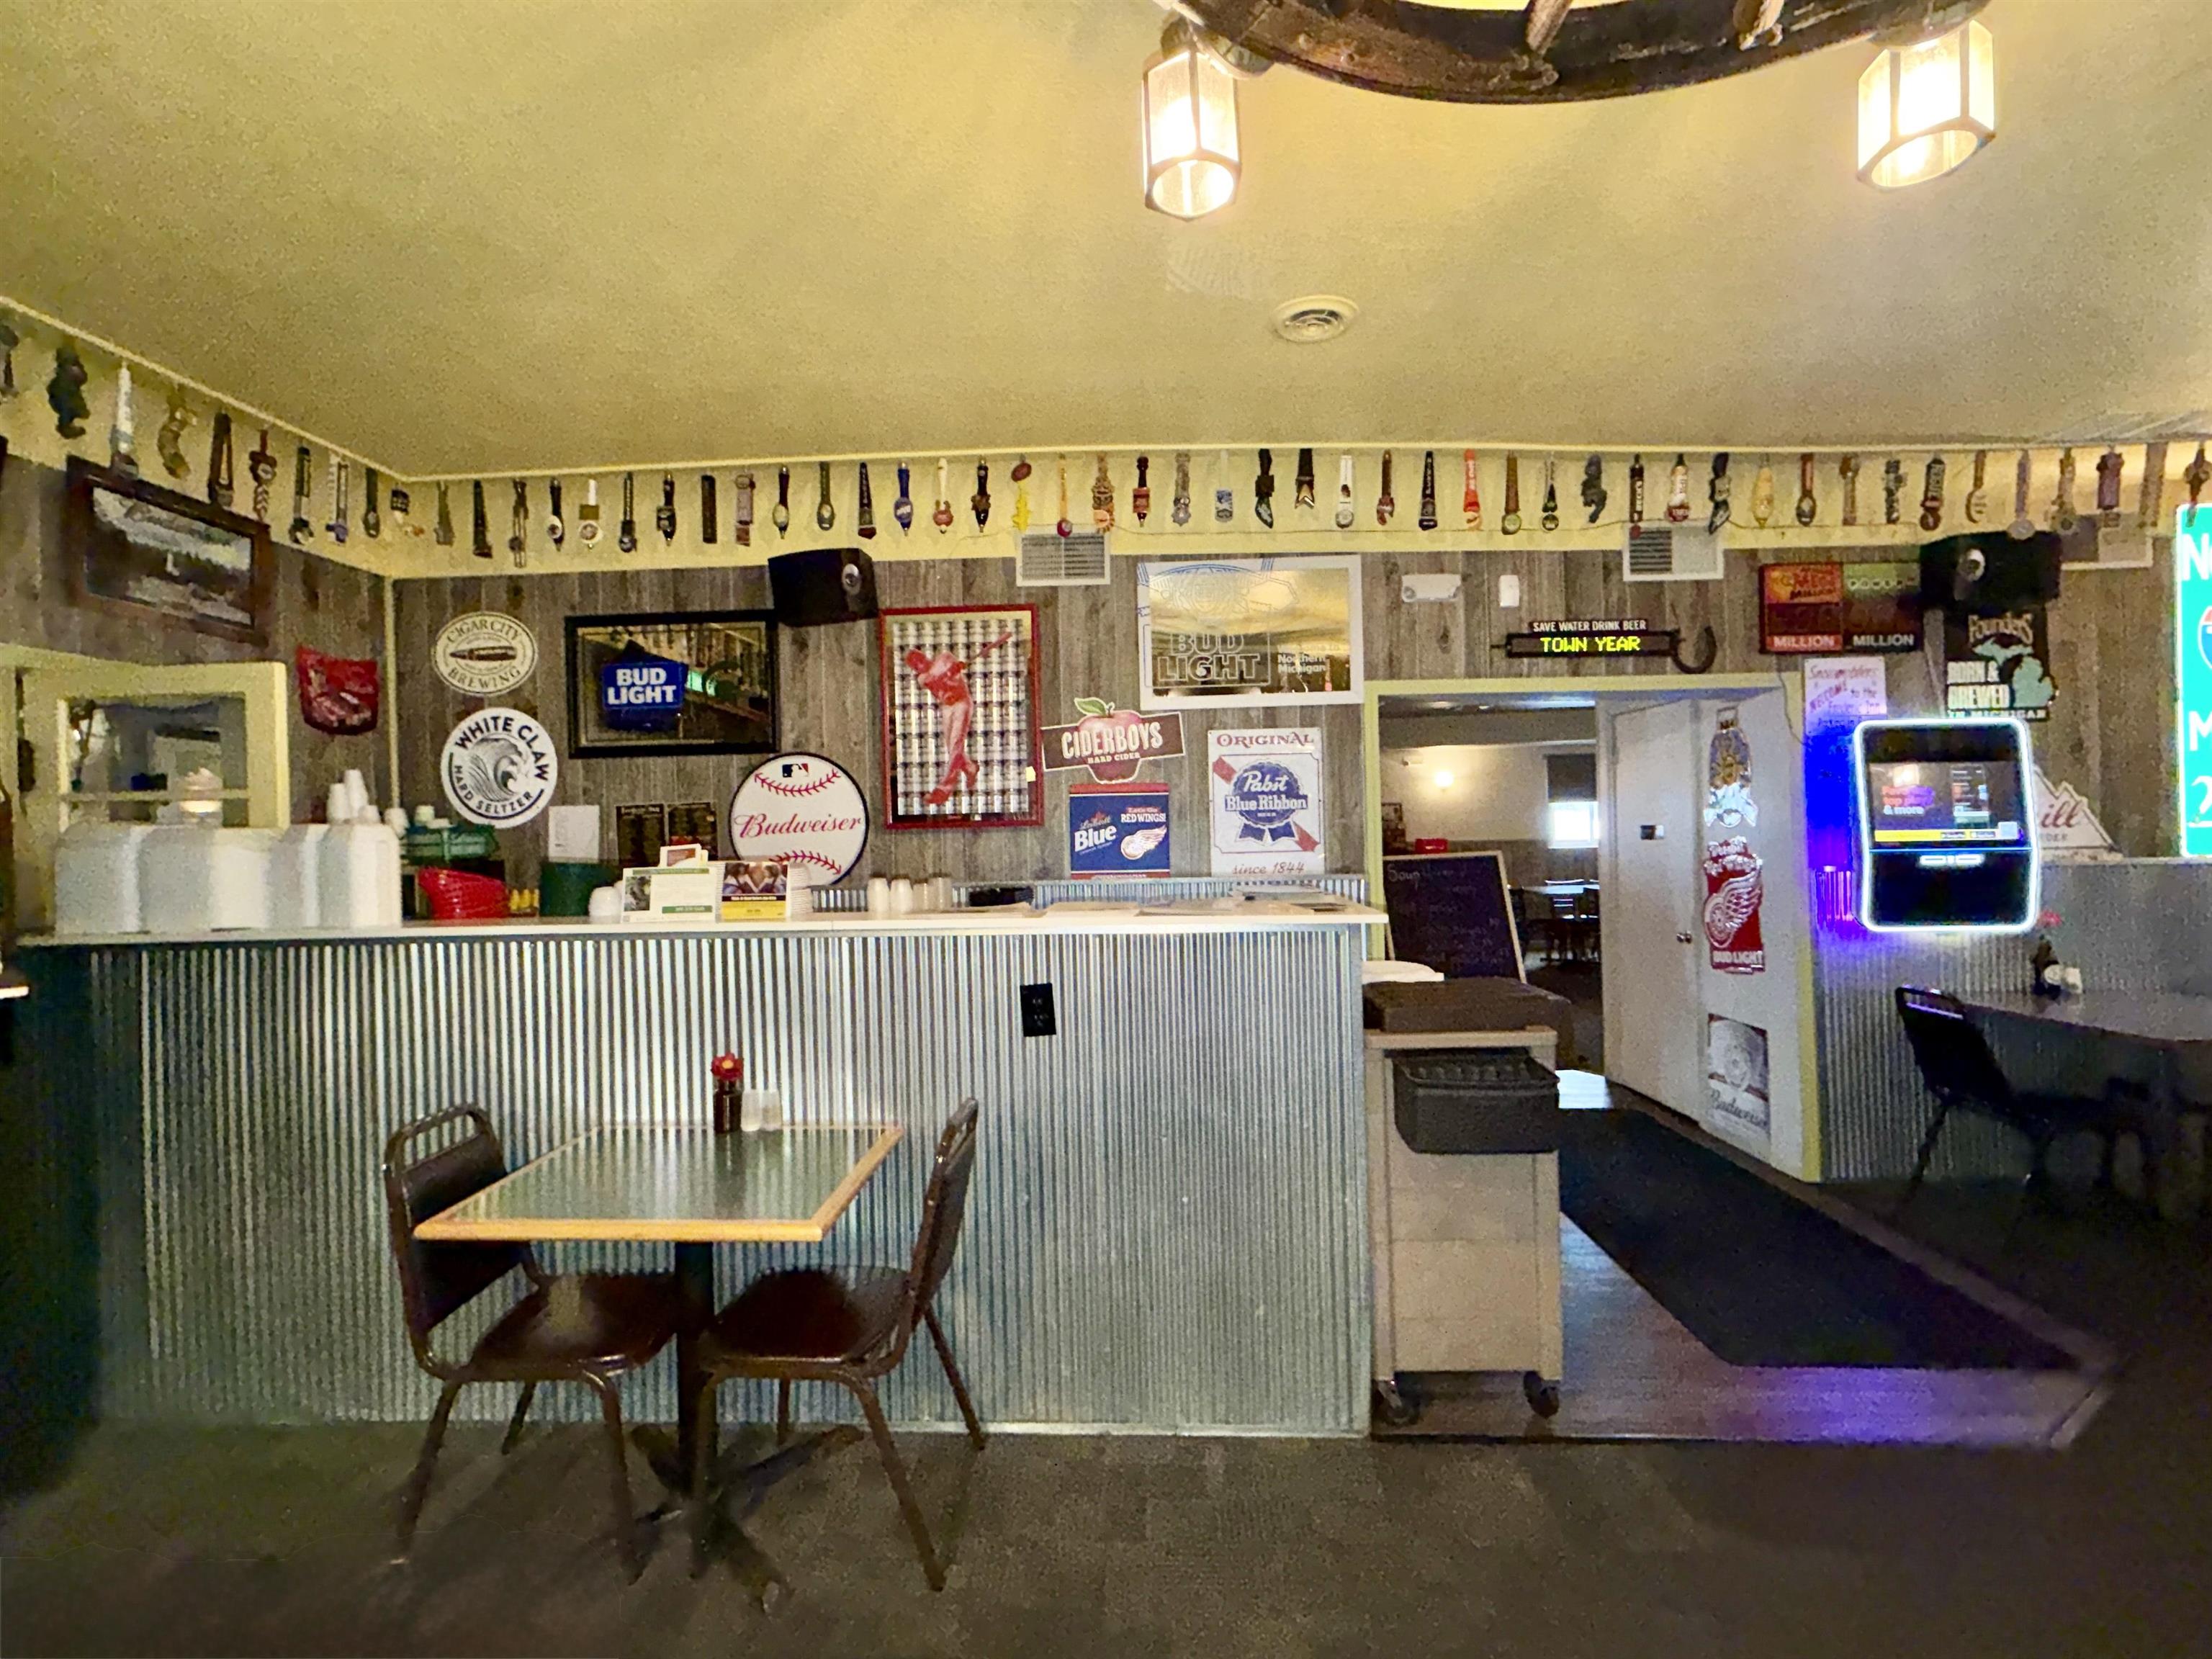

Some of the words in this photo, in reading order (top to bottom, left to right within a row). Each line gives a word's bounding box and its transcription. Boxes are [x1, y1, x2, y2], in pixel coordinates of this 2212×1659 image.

[446, 619, 489, 643] CIGAR
[490, 619, 522, 642] CITY
[1533, 621, 1556, 632] SAVE
[1559, 621, 1590, 632] WATER
[1592, 620, 1620, 631] DRINK
[1623, 619, 1646, 631] BEER
[1170, 631, 1245, 656] BUD
[1539, 637, 1588, 653] TOWN
[1595, 636, 1641, 652] YEAR
[1773, 635, 1835, 647] MILLION
[1853, 634, 1915, 647] MILLION
[448, 665, 521, 690] BREWING
[616, 667, 668, 686] BUD
[1157, 652, 1261, 681] LIGHT
[1946, 661, 1986, 684] BORN
[1987, 660, 2000, 682] &
[607, 685, 678, 705] LIGHT
[1947, 684, 2010, 709] BREWED
[455, 715, 515, 751] WHITE
[517, 724, 550, 781] CLAW
[1061, 721, 1164, 760] CIDERBOYS
[1216, 732, 1315, 749] ORIGINAL
[1088, 755, 1112, 765] HARD
[1114, 752, 1141, 762] CIDER
[453, 765, 474, 802] HARD
[475, 790, 534, 815] SELTZER
[1243, 770, 1289, 793] Pabst
[1226, 795, 1258, 811] Blue
[1258, 793, 1308, 811] Ribbon
[734, 812, 863, 839] Budweiser
[1120, 813, 1137, 823] RED
[1137, 812, 1166, 823] WINGS!
[2040, 799, 2081, 829] ill
[1074, 825, 1117, 852] Blue
[1232, 863, 1267, 875] since
[1272, 861, 1305, 874] 1844
[1733, 950, 1763, 963] LIGHT
